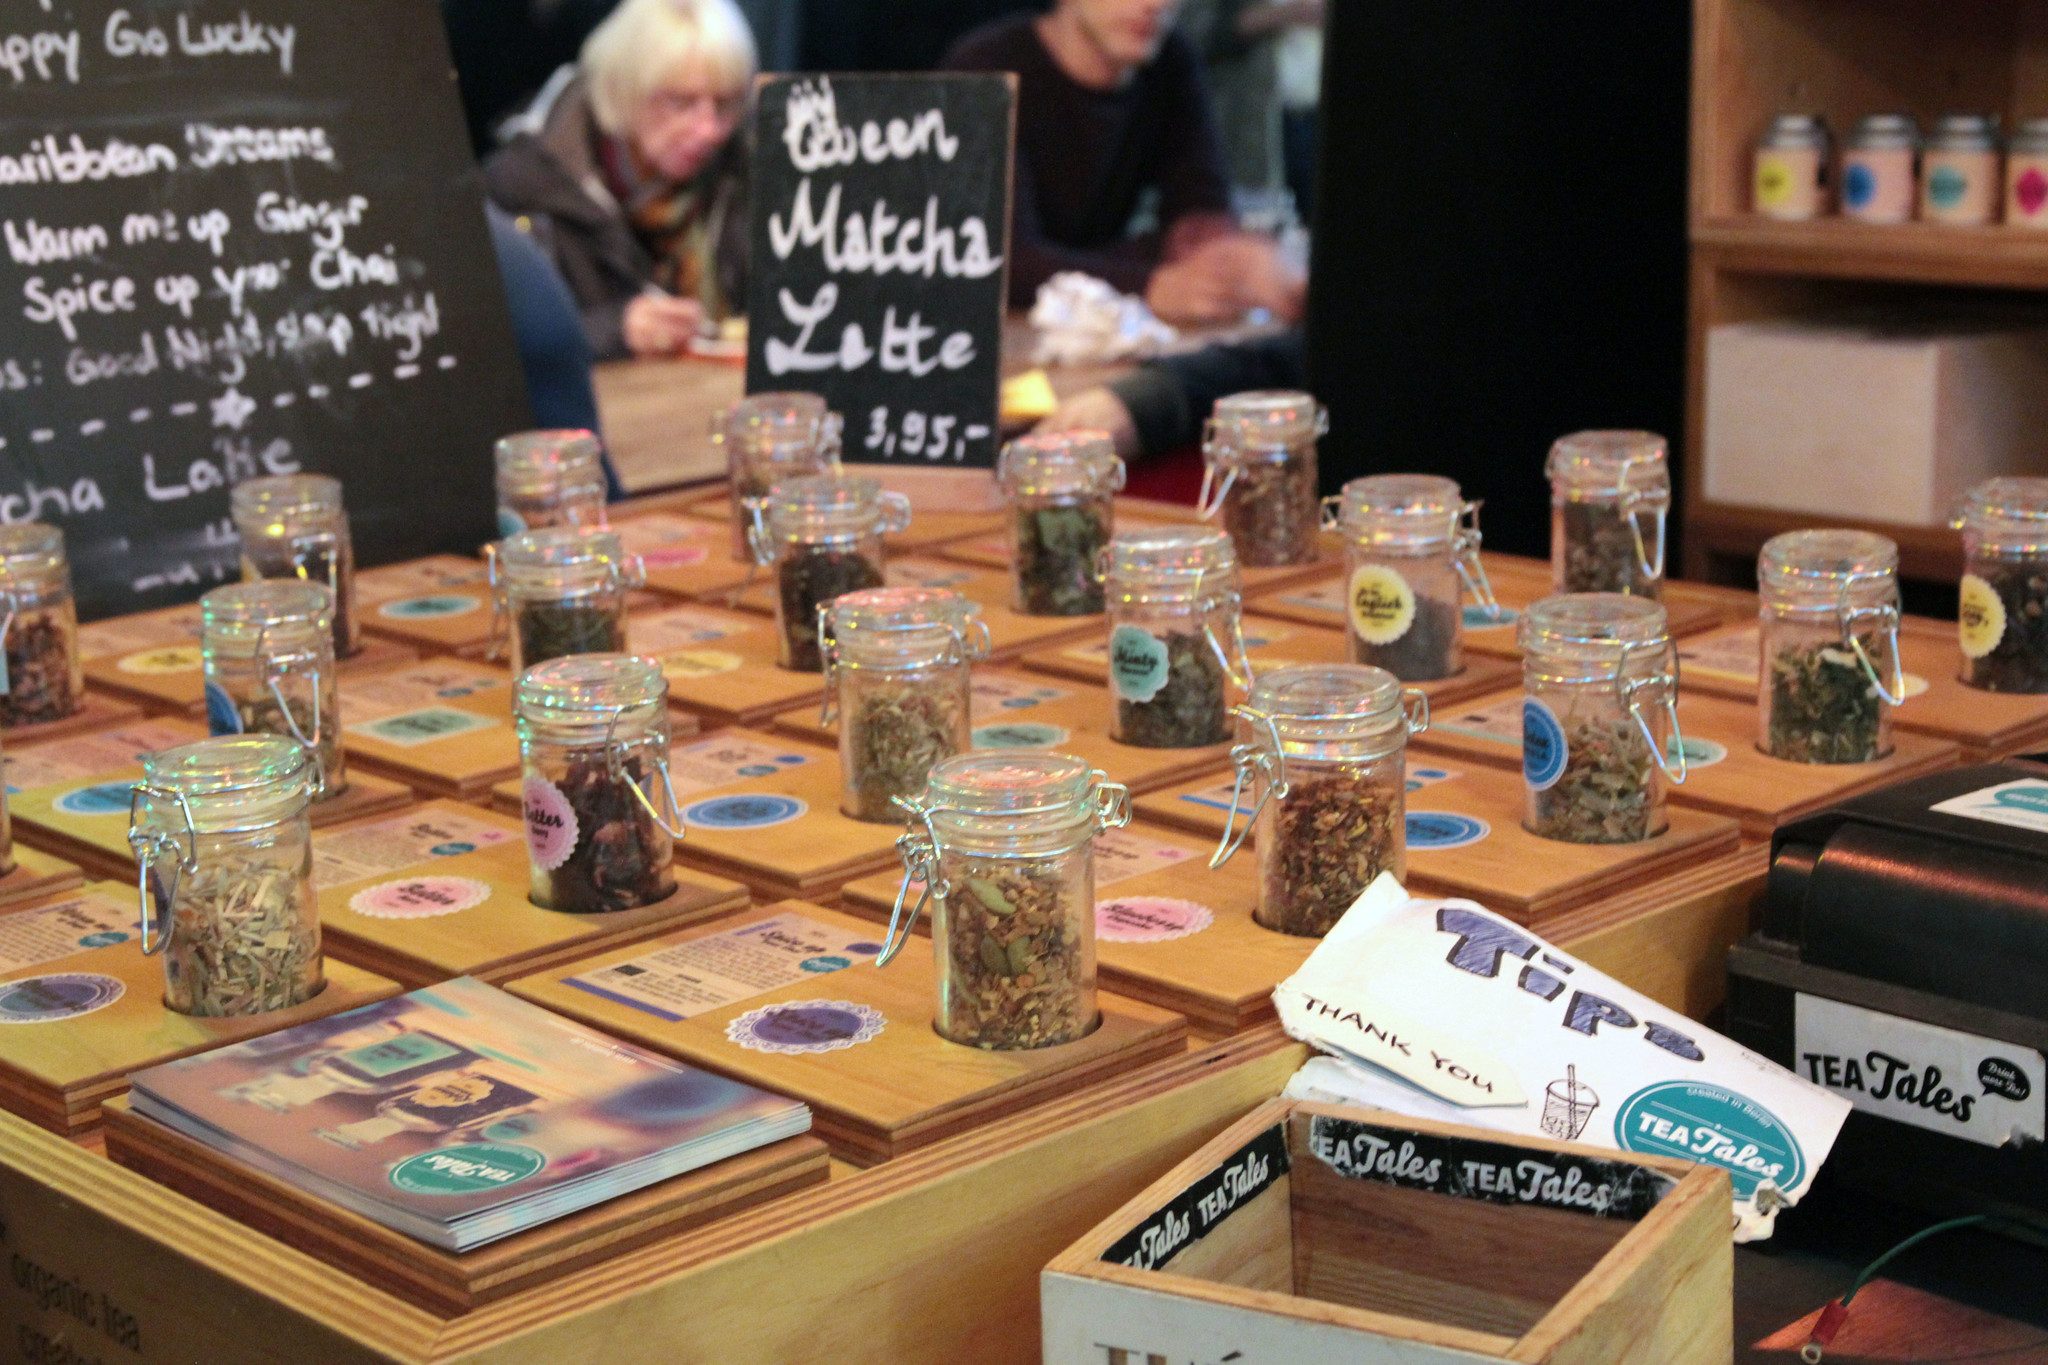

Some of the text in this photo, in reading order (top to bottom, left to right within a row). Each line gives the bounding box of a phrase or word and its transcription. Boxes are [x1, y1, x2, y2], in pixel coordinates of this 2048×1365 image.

[104, 10, 169, 57] Go
[178, 10, 295, 74] Lucky
[784, 90, 958, 172] Queen
[3, 218, 108, 266] Warm
[187, 208, 230, 257] up
[768, 177, 1004, 278] Matcha
[23, 275, 136, 341] Spice
[154, 275, 200, 318] up
[310, 245, 398, 290] Chai
[66, 331, 159, 386] Good
[765, 282, 977, 377] Latte
[1302, 993, 1494, 1094] THANK YOU
[1803, 1052, 1866, 1092] TEA
[1865, 1050, 1976, 1122] Tales
[1353, 1133, 1444, 1183] Tales
[1638, 1111, 1785, 1178] TEA Tales
[1196, 1150, 1270, 1227] TEA Tales
[1462, 1159, 1613, 1208] TEA Tales
[1140, 1210, 1191, 1270] Tales
